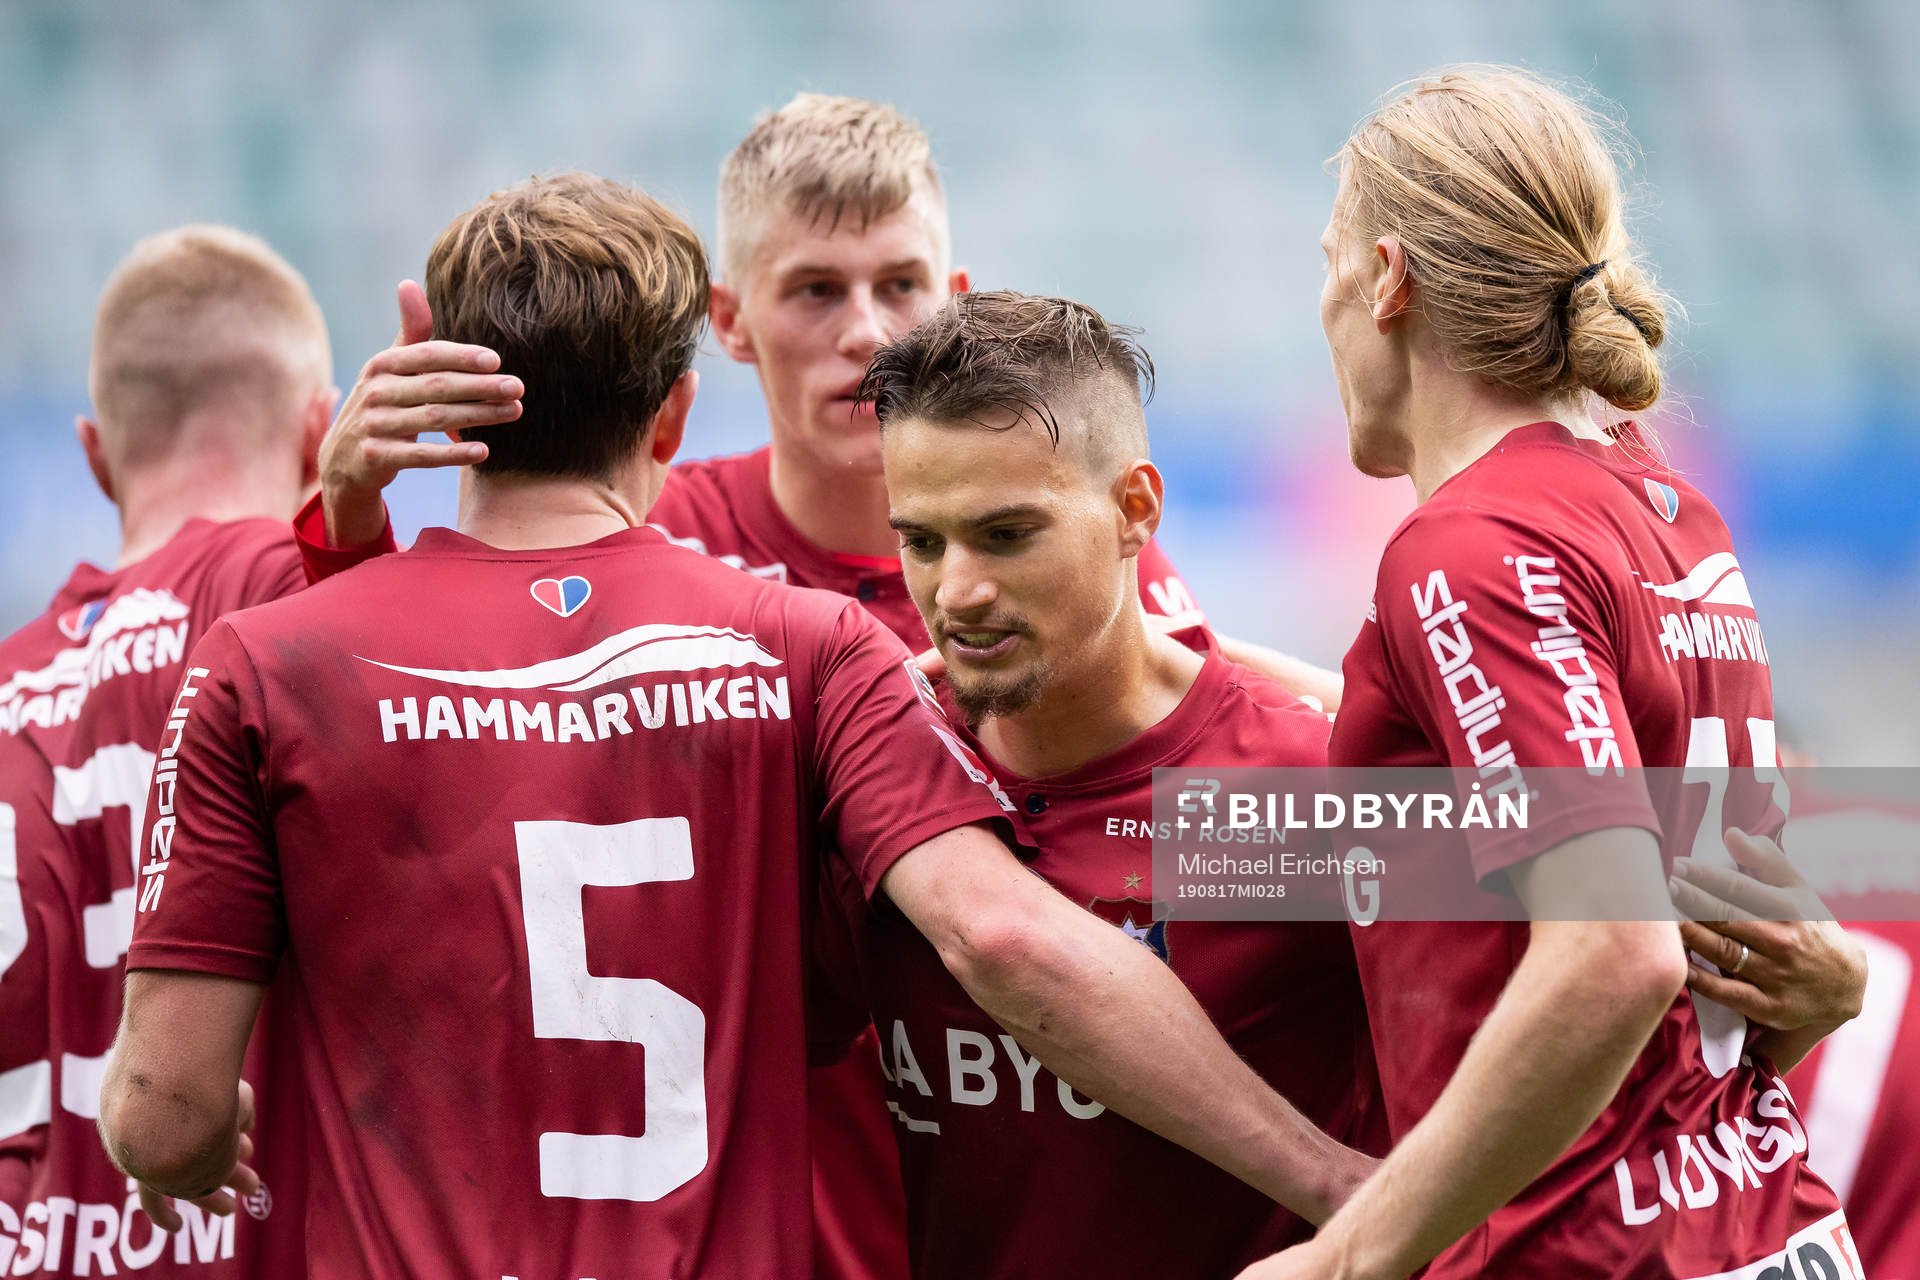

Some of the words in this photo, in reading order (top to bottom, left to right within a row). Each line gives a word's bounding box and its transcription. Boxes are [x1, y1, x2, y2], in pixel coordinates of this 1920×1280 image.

[378, 675, 792, 744] HAMMARVIKEN
[1410, 569, 1532, 822] stadium
[1515, 555, 1625, 778] stadium
[137, 666, 210, 913] stadium
[1105, 816, 1185, 841] ERNST
[1198, 819, 1287, 845] ROSÉN
[513, 816, 709, 1203] 5
